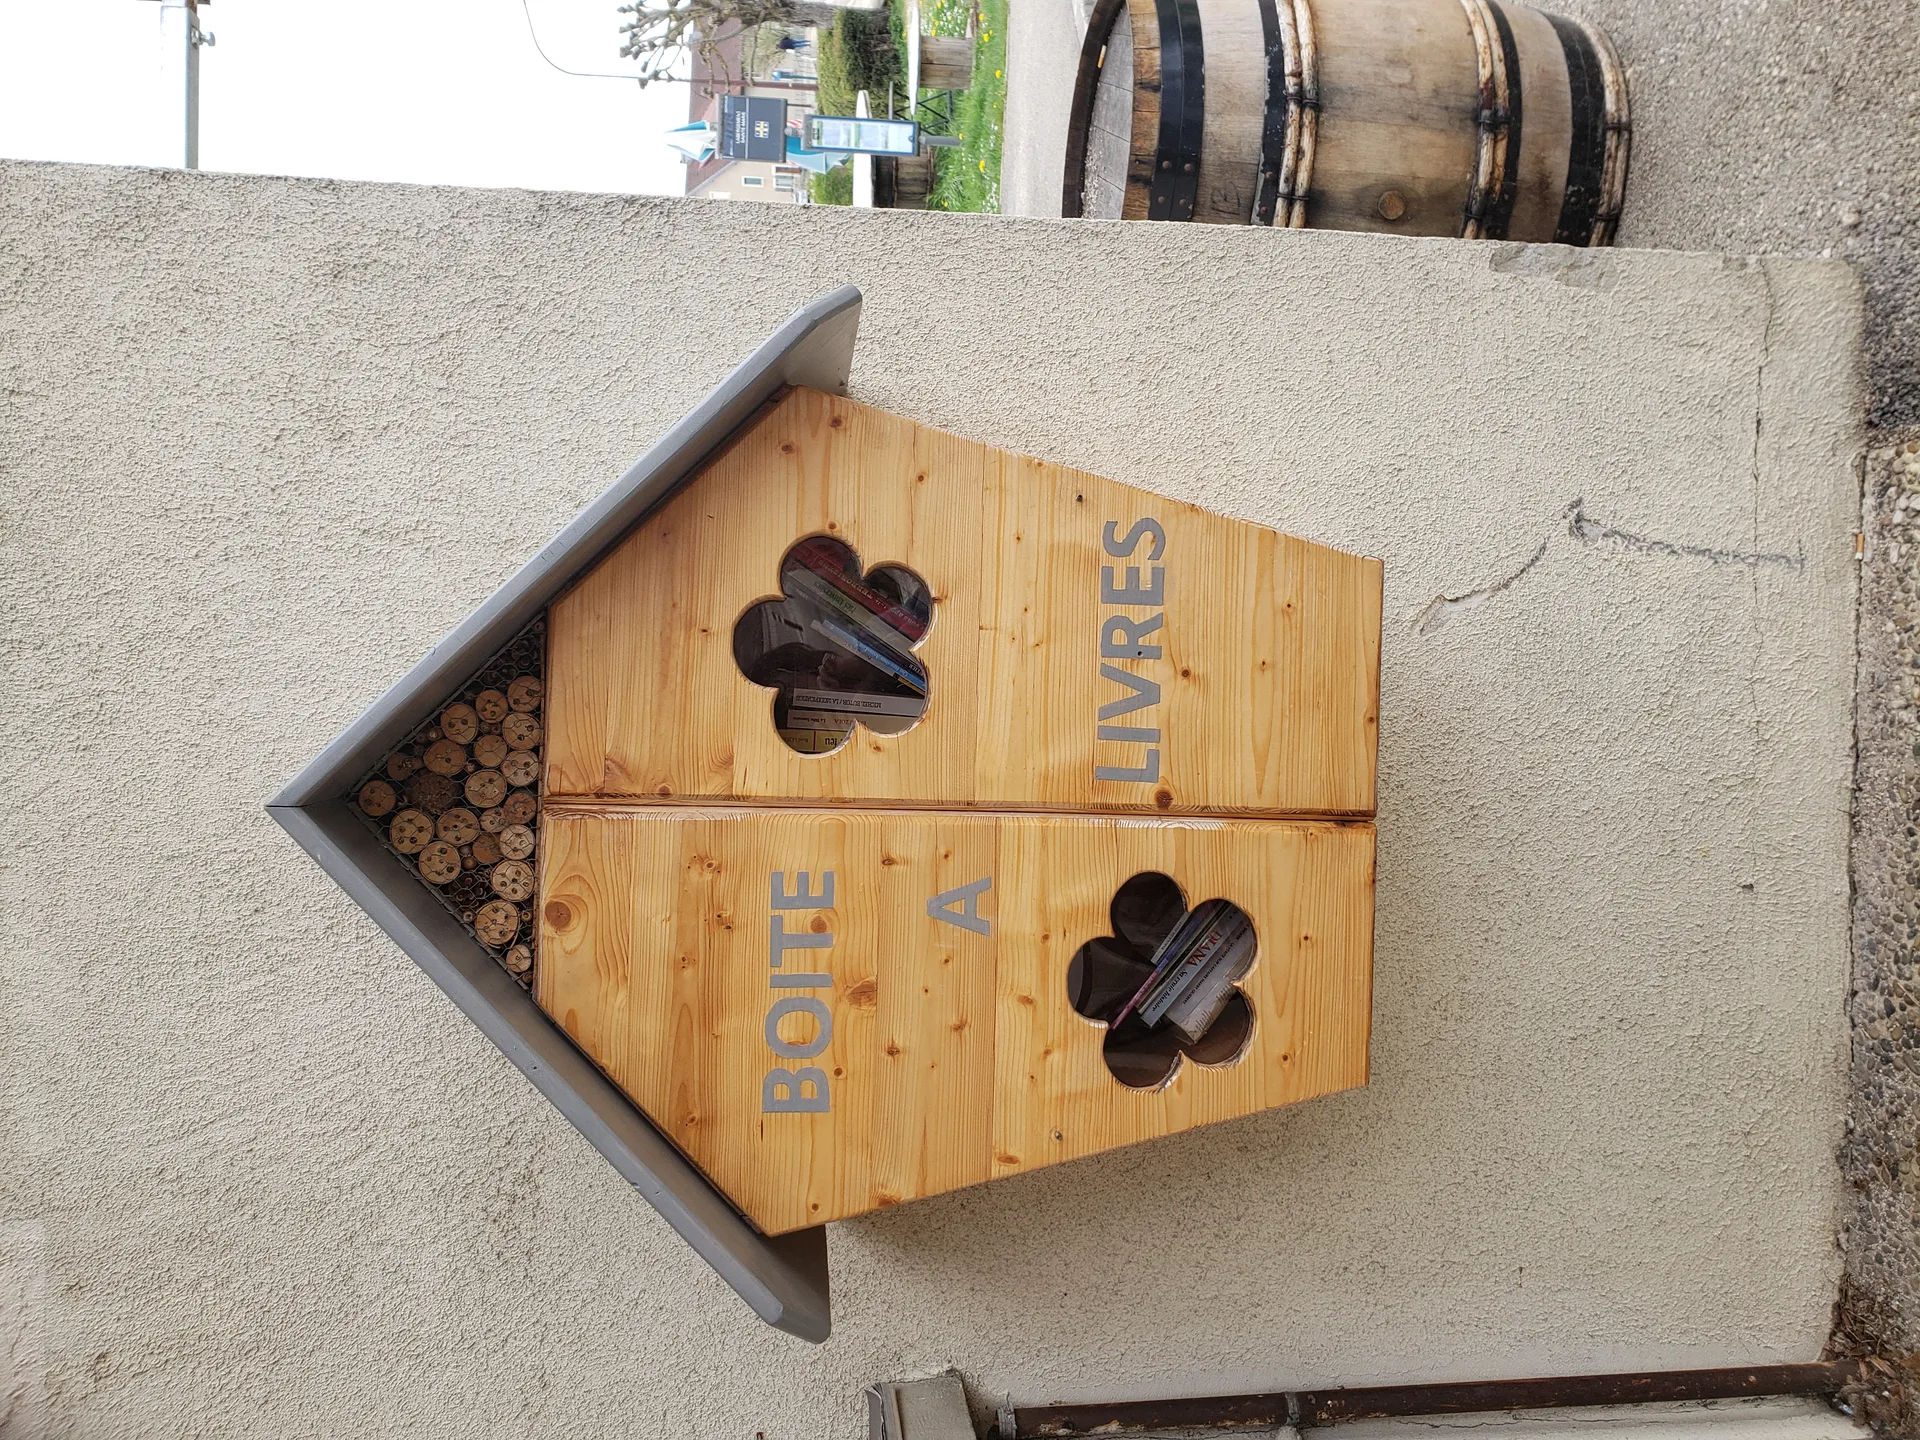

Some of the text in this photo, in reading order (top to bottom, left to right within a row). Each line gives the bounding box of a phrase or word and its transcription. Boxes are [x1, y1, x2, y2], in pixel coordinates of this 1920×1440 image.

[1094, 517, 1166, 783] LIVRES
[927, 875, 992, 937] A
[1185, 930, 1223, 968] DIANA
[762, 870, 835, 1113] BOITE
